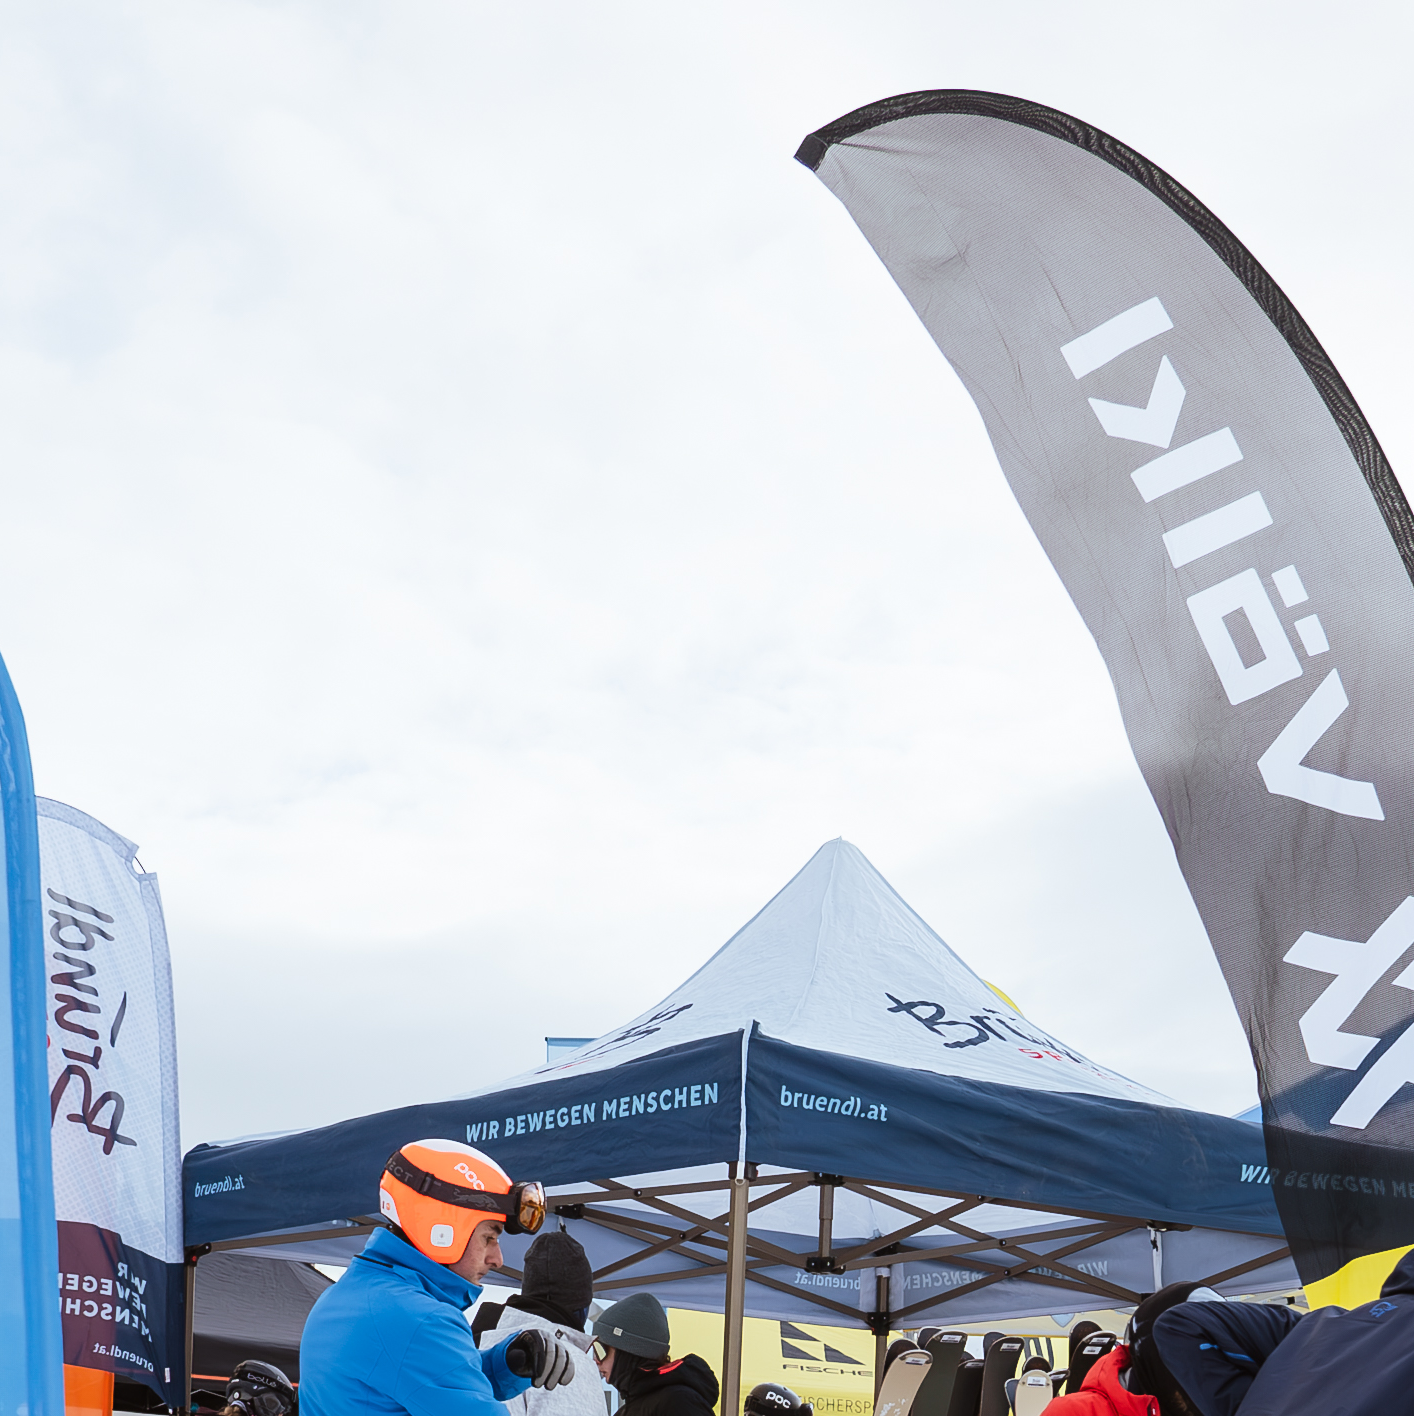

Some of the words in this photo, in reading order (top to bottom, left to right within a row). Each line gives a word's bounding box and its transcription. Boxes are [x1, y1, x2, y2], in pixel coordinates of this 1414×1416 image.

[465, 1121, 500, 1143] WIR
[503, 1102, 596, 1138] BEWEGEN
[601, 1081, 719, 1123] MENSCHEN
[780, 1085, 889, 1124] bruendl.at
[193, 1173, 246, 1199] bruendl.at
[782, 1363, 874, 1378] FISCHE
